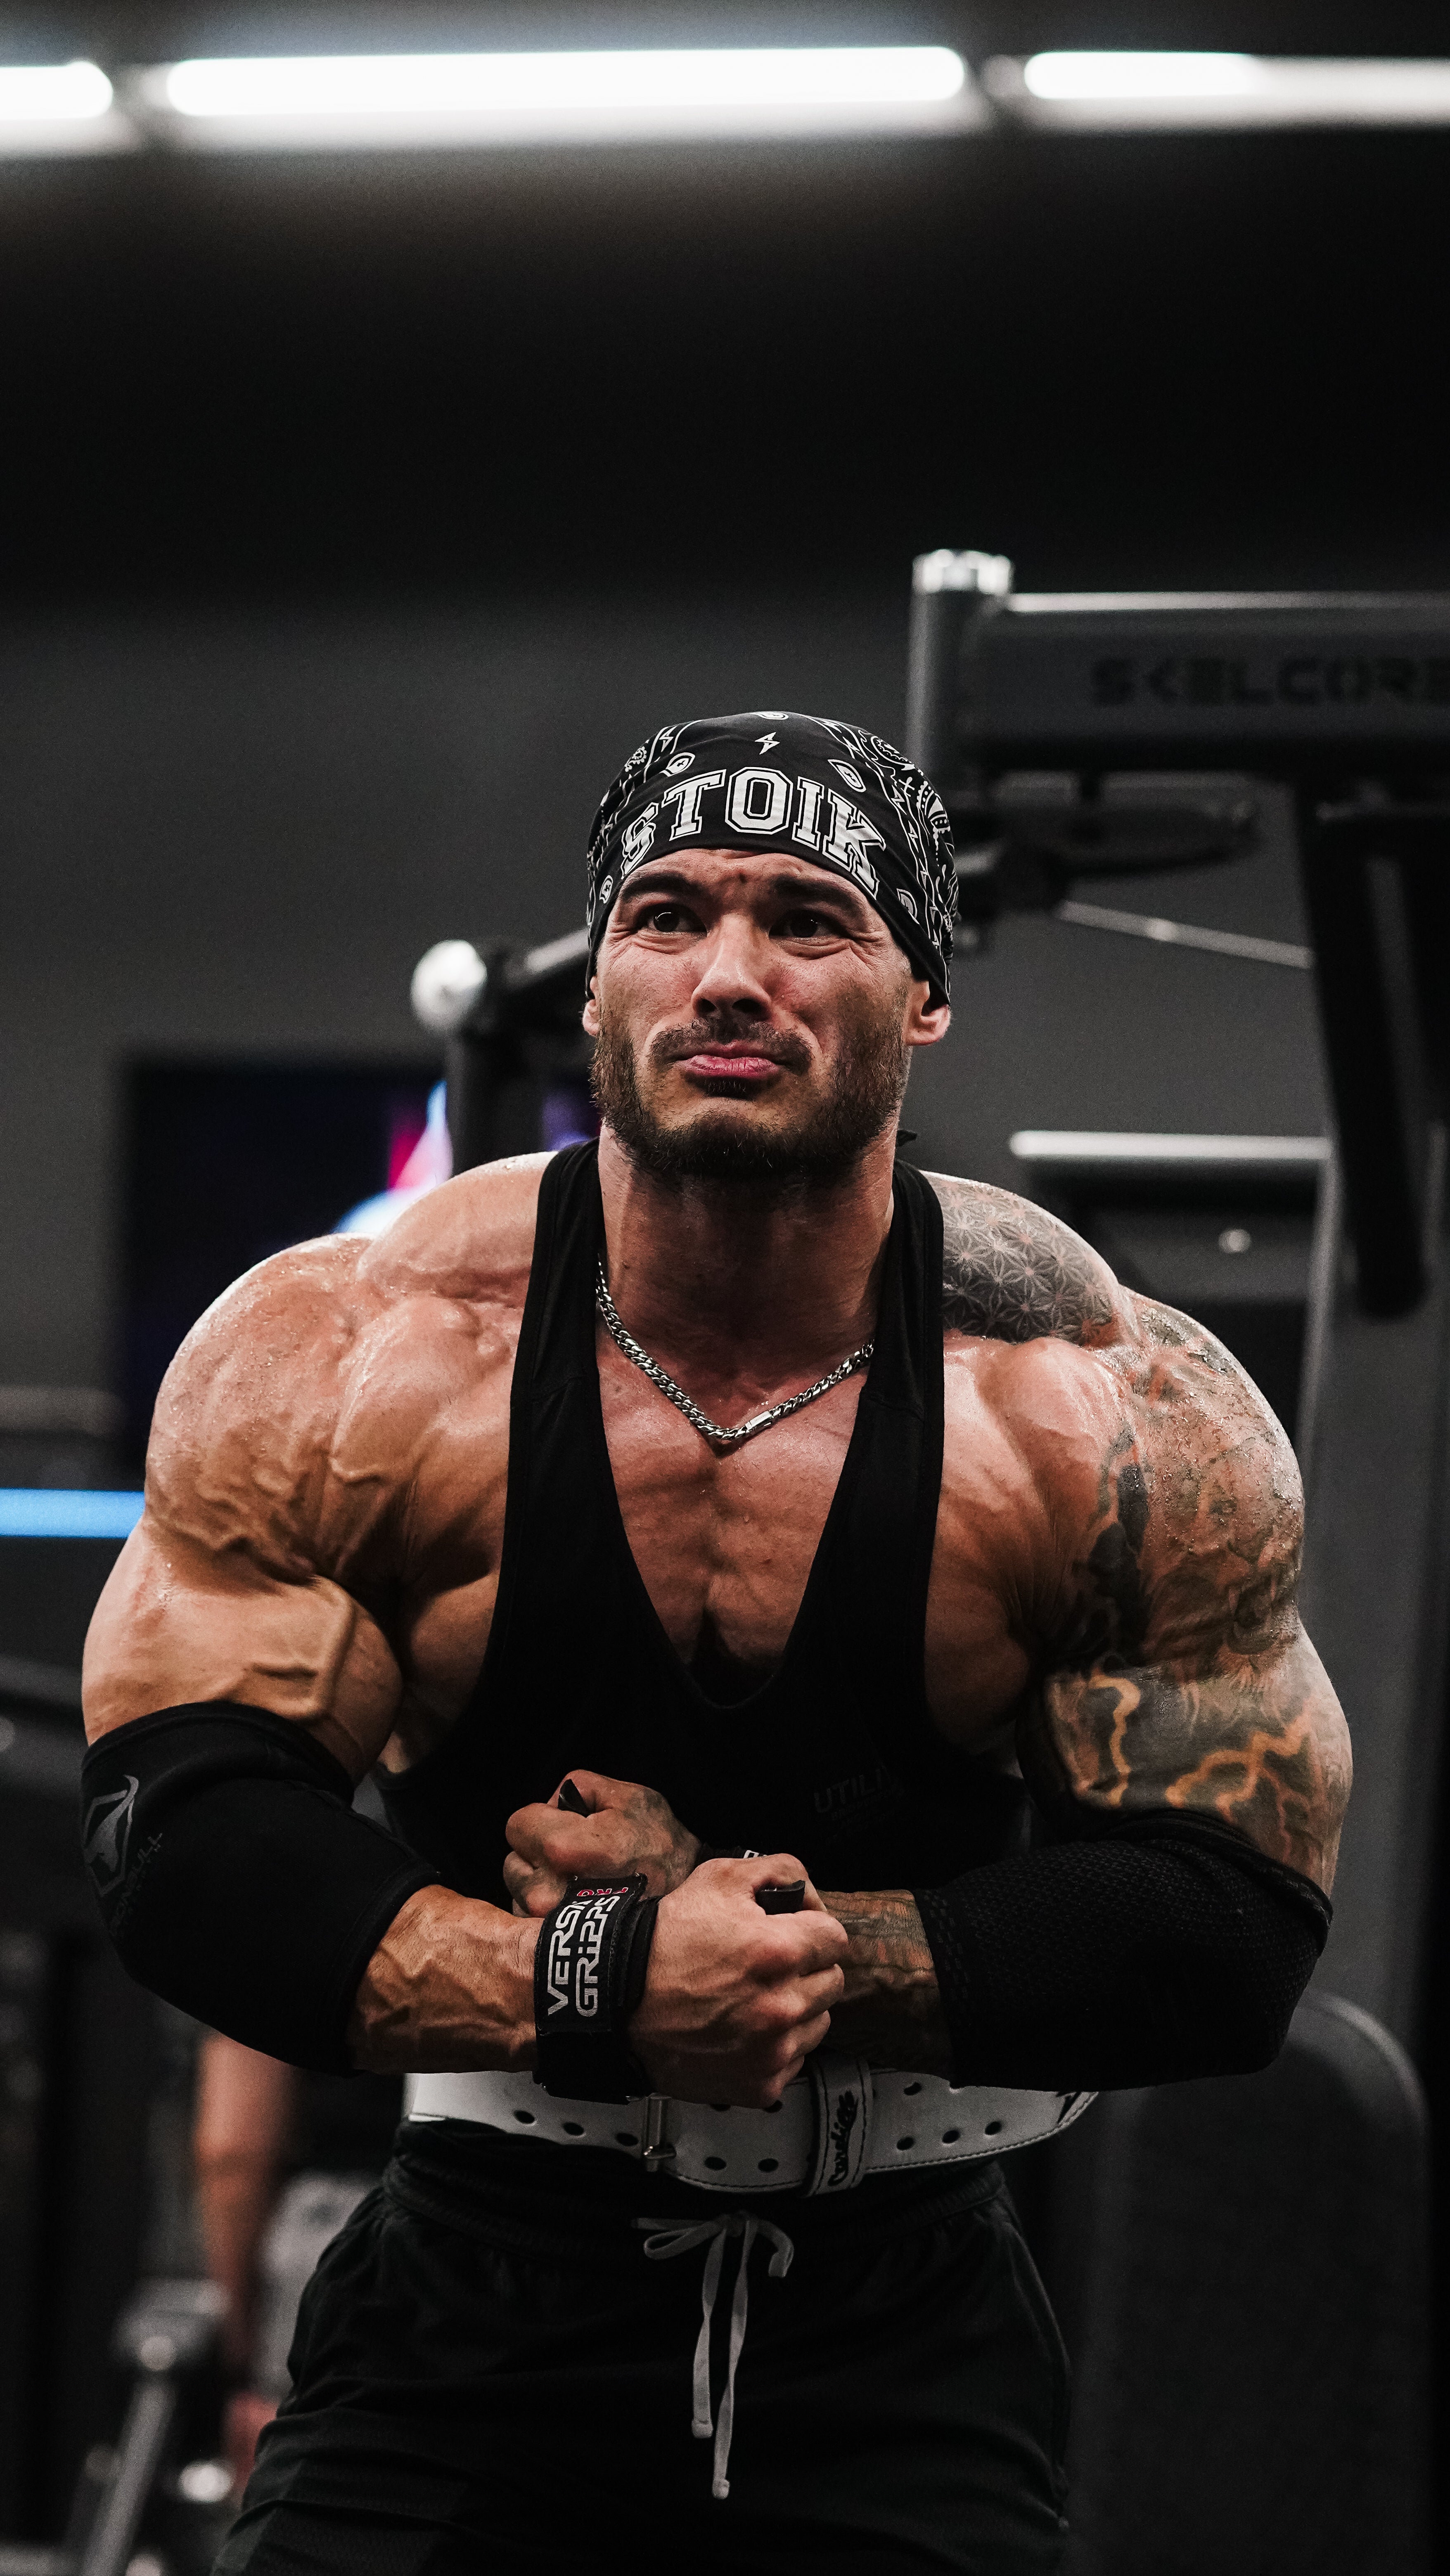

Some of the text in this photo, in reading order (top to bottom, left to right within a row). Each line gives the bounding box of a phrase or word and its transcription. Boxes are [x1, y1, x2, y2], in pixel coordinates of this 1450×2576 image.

[621, 766, 886, 899] STOIK
[813, 1767, 884, 1813] UTILI
[547, 1899, 594, 2016] VERSA
